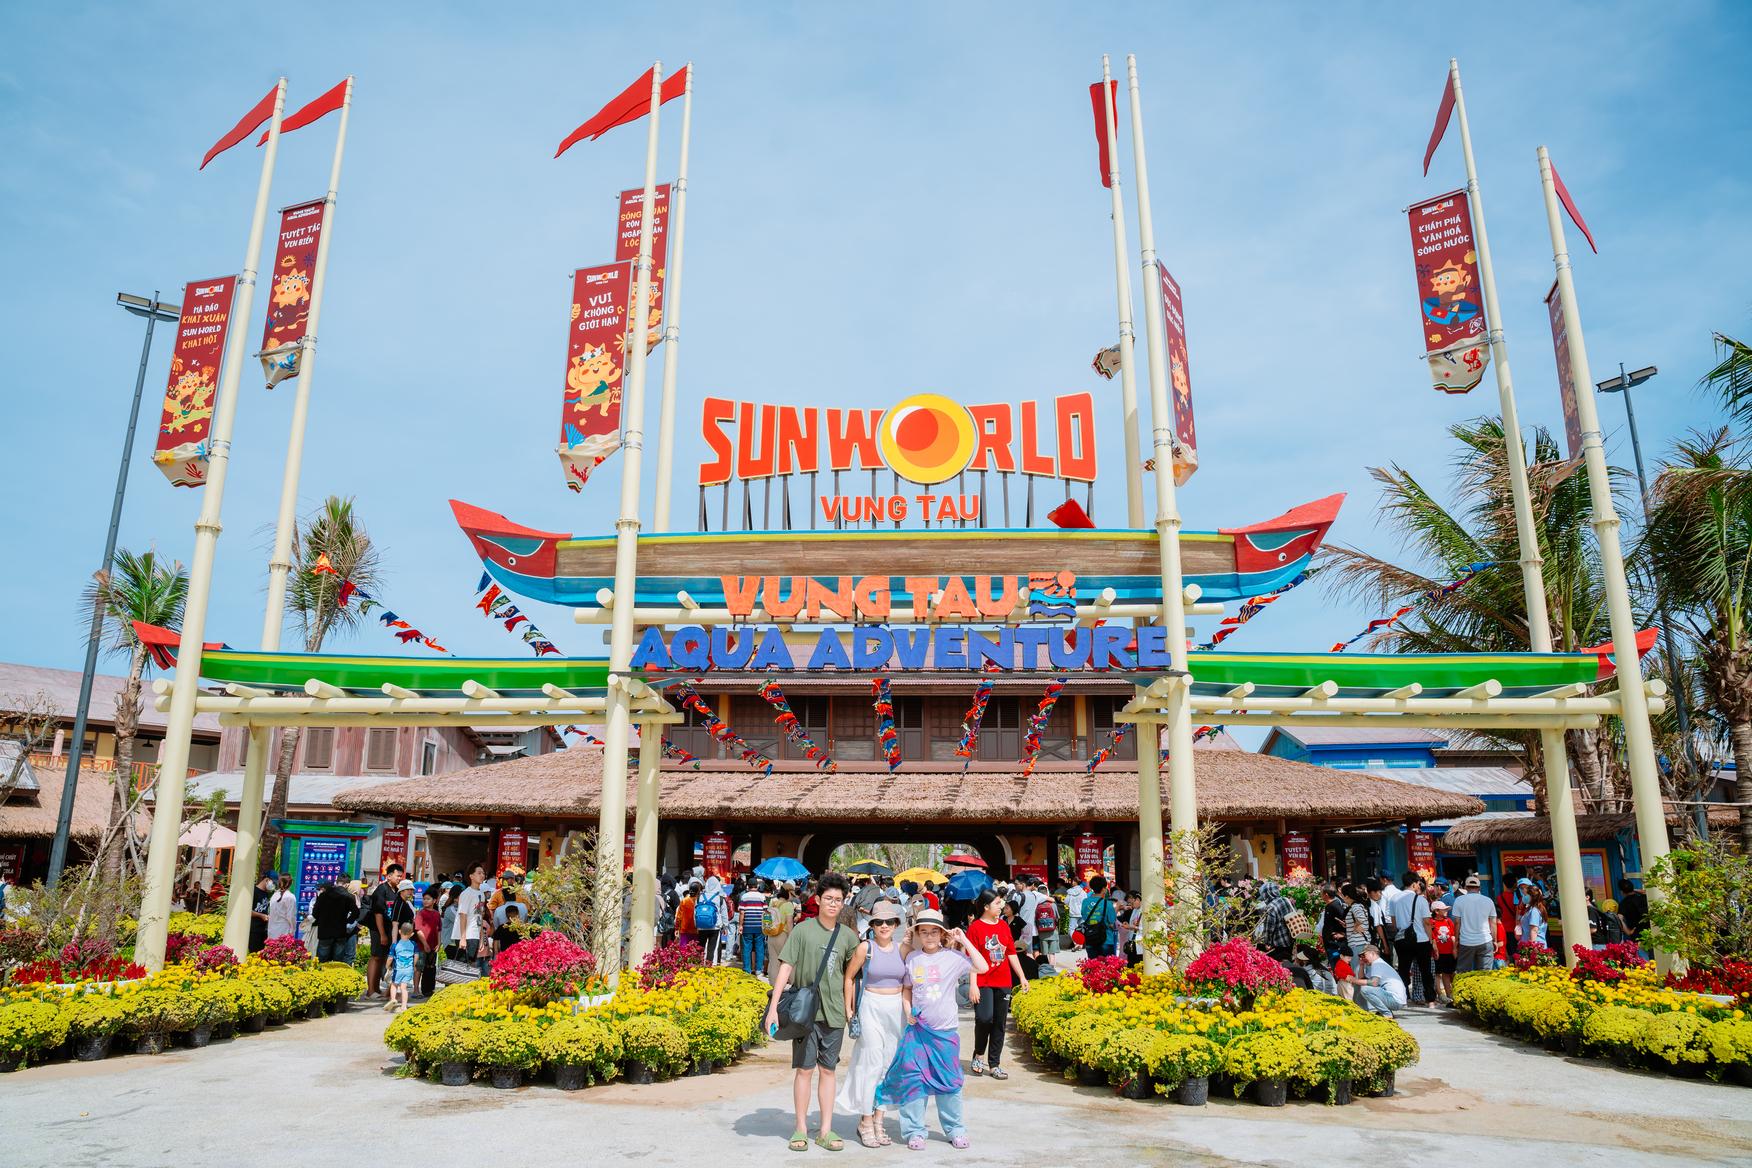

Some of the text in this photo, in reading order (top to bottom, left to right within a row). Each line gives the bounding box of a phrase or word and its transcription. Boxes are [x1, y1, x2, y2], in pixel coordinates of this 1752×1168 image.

[620, 211, 642, 221] SÓNG
[1418, 213, 1461, 233] KHÁM PHÁ
[307, 222, 321, 233] TÁC
[1422, 224, 1461, 244] VĂN HOÁ
[1417, 234, 1470, 256] SÔNG NƯỚC
[589, 292, 612, 306] VUI
[181, 313, 226, 324] KHAI XUÂN
[584, 305, 614, 318] KHÔNG
[578, 316, 619, 331] GIỚI HẠN
[182, 325, 221, 337] SUN WORLD
[182, 338, 202, 349] KHAI
[820, 494, 981, 522] VUNG TAU
[720, 575, 1019, 619] VUNG TAU
[629, 626, 1171, 672] AQUA ADVENTURE
